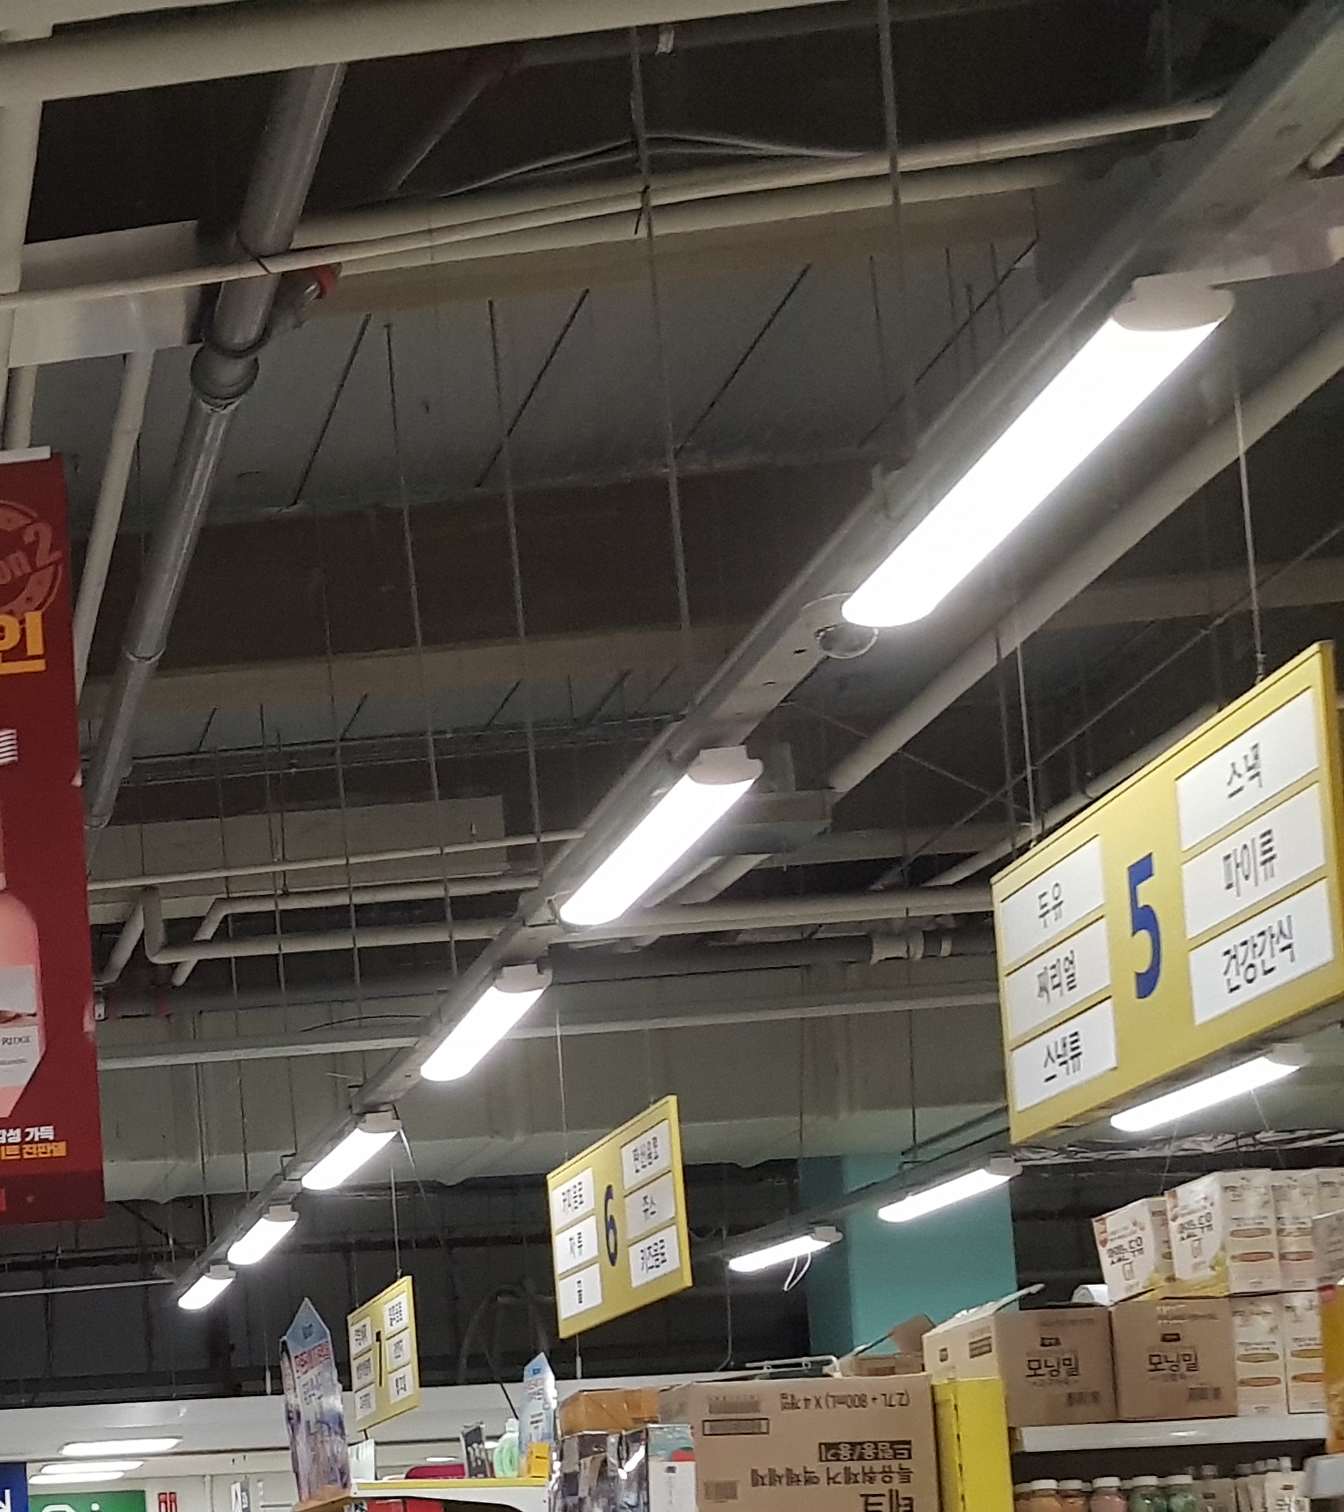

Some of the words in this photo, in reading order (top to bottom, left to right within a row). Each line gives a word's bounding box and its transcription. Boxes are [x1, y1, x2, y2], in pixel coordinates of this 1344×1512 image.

[1227, 742, 1264, 799] 스낵
[1222, 828, 1279, 898] 파이류
[1037, 880, 1064, 930] 두유
[1127, 851, 1162, 1000] 5
[1221, 913, 1296, 994] 건강간식
[1043, 1030, 1084, 1084] 스낵류
[24, 1125, 55, 1142] 가득
[604, 1184, 619, 1267] 6
[1025, 1356, 1081, 1378] 모닝밀
[1147, 1351, 1200, 1373] 모닝밀
